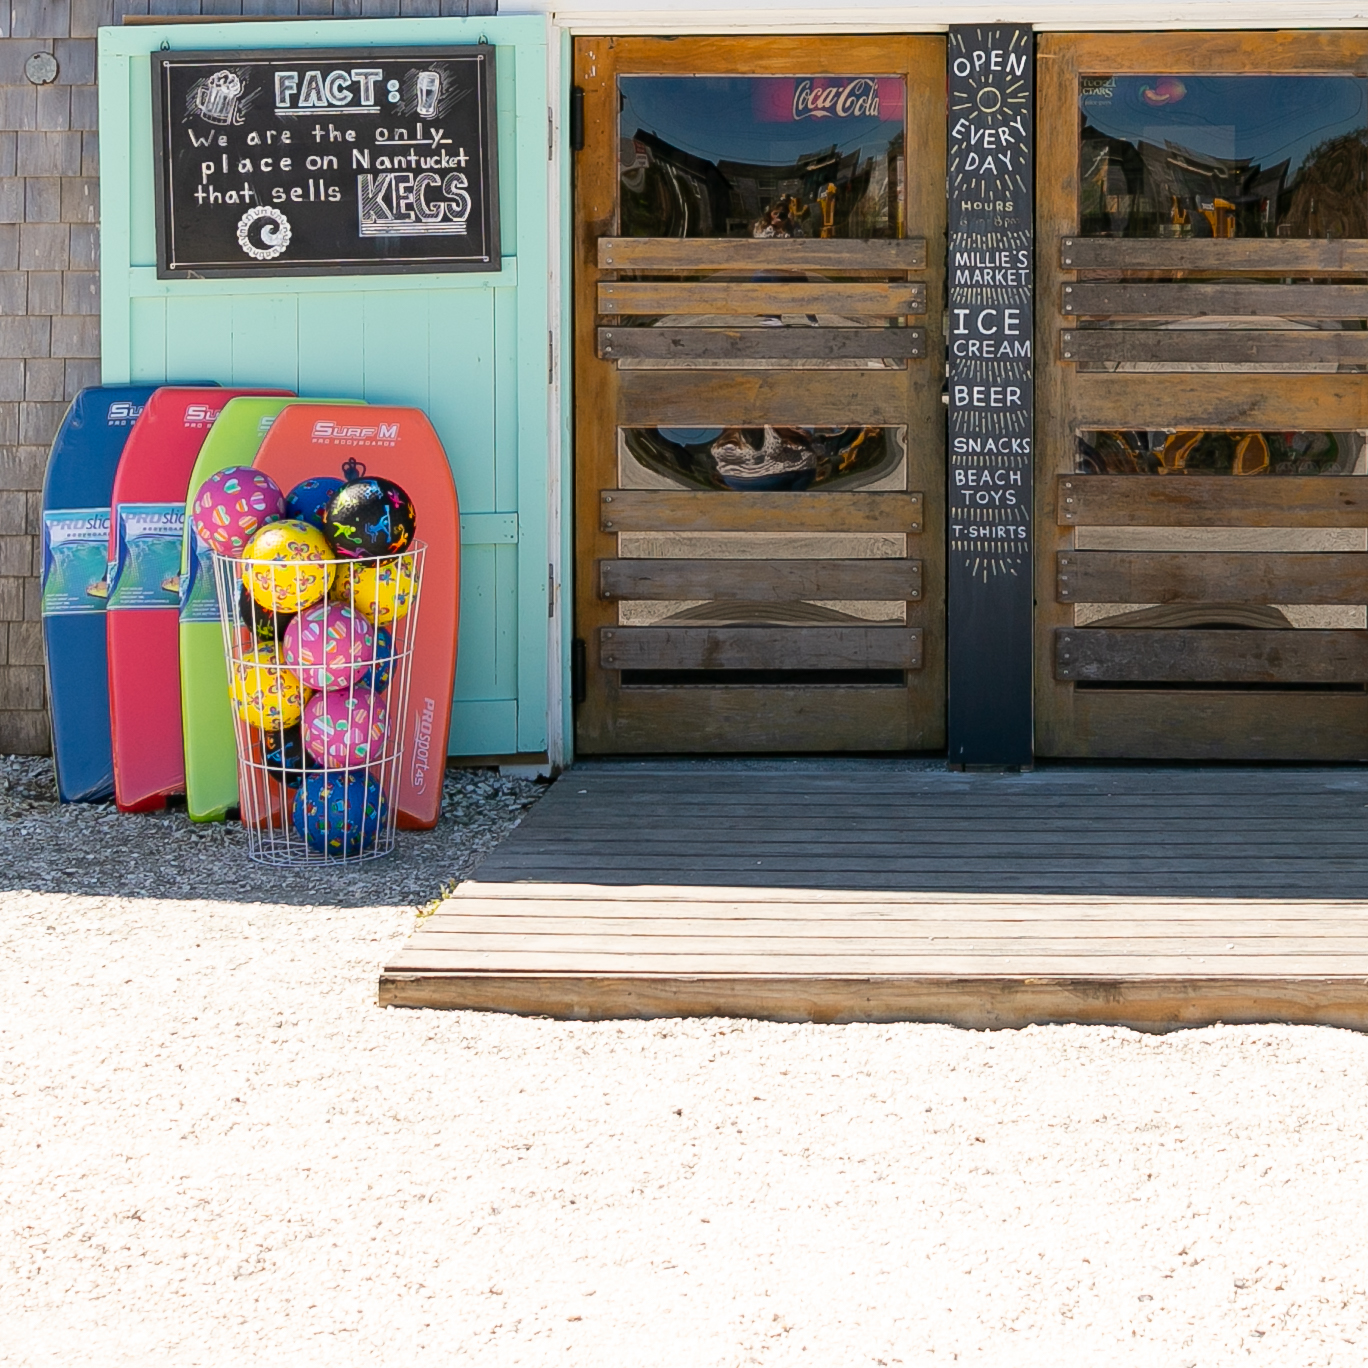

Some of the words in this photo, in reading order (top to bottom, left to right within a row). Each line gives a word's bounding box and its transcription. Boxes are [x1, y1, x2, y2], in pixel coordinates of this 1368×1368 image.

[953, 50, 1027, 77] OPEN
[792, 78, 879, 120] Coca-Cola
[188, 128, 228, 148] We
[247, 129, 291, 146] are
[312, 124, 356, 143] the
[375, 122, 445, 148] only
[952, 116, 1026, 148] EVERY
[201, 153, 292, 184] place
[305, 155, 338, 171] on
[352, 148, 470, 170] Nantucket
[965, 150, 1013, 175] DAY
[194, 182, 254, 205] that
[272, 179, 341, 202] sells
[358, 172, 472, 223] KEGS
[961, 200, 1014, 211] HOURS
[955, 249, 1028, 268] MILLIE'S
[955, 269, 1029, 285] MARKET
[953, 309, 1020, 335] ICE
[953, 340, 1031, 358] CREAM
[954, 386, 1022, 407] BEER
[953, 437, 1031, 454] SNACKS
[955, 470, 1022, 486] BEACH
[961, 490, 1016, 505] TOYS
